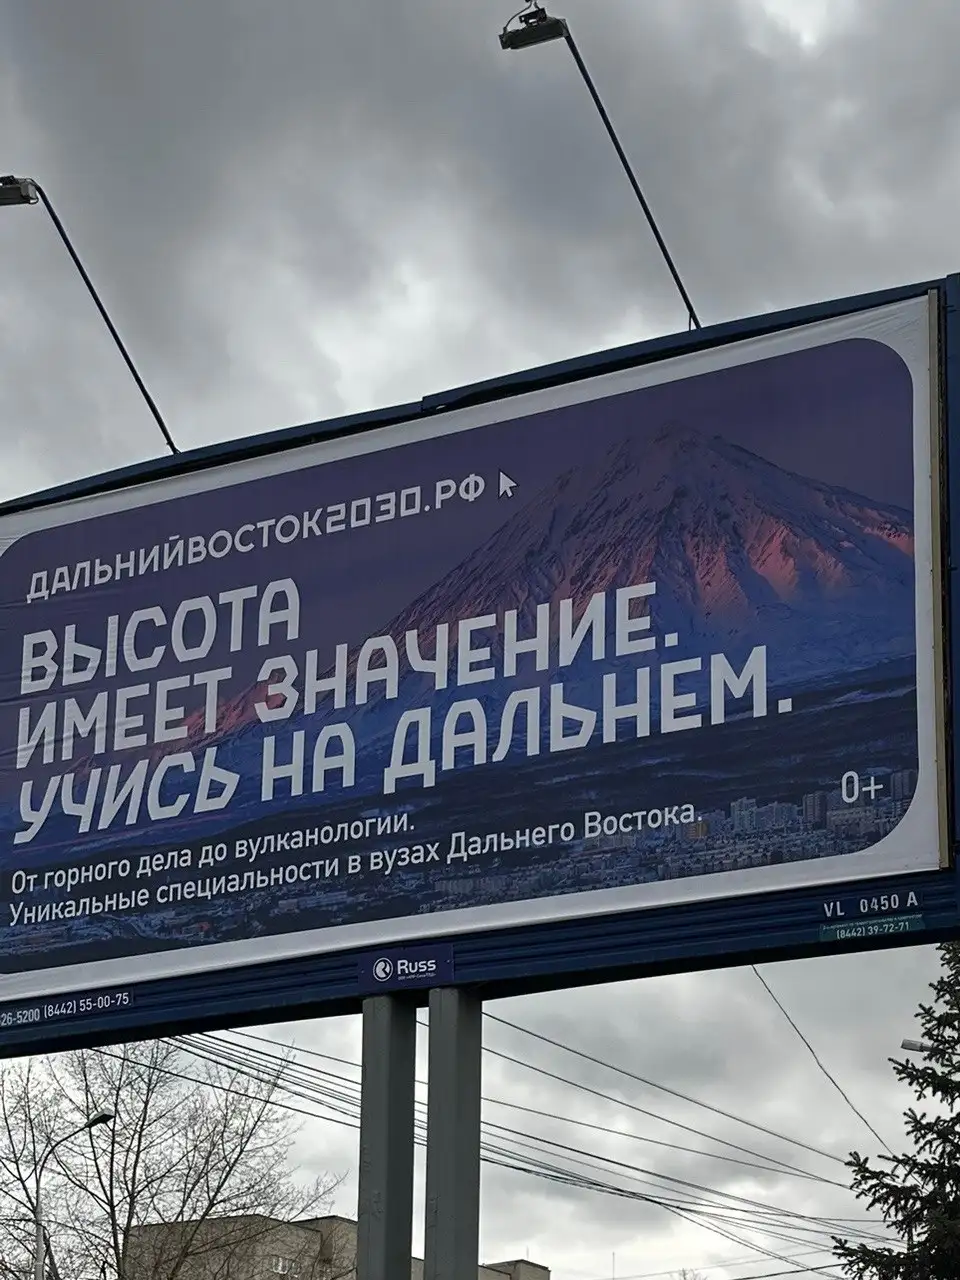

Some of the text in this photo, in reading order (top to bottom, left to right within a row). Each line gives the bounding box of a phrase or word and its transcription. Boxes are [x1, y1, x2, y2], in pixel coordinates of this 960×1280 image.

[27, 473, 486, 604] ДАЛЬНИЙВОСТОК2030.РФ
[16, 581, 679, 769] ИМЕЕТ ЗНАЧЕНИЕ.
[20, 577, 301, 695] ВЫСОТА
[13, 645, 793, 845] УЧИСЬ НА ДАЛЬНЕМ.
[840, 770, 884, 804] 0+
[8, 803, 703, 928] Уникальные специальности в вузах Дальнего Востока.
[11, 811, 416, 895] От горного дела до вулканологии.
[823, 891, 919, 918] VL 0450 A
[836, 926, 866, 940] (8442)
[868, 921, 910, 936] 39-72-71
[43, 999, 77, 1019] (8442)
[79, 992, 130, 1012] 55-00-75
[397, 959, 437, 975] Russ
